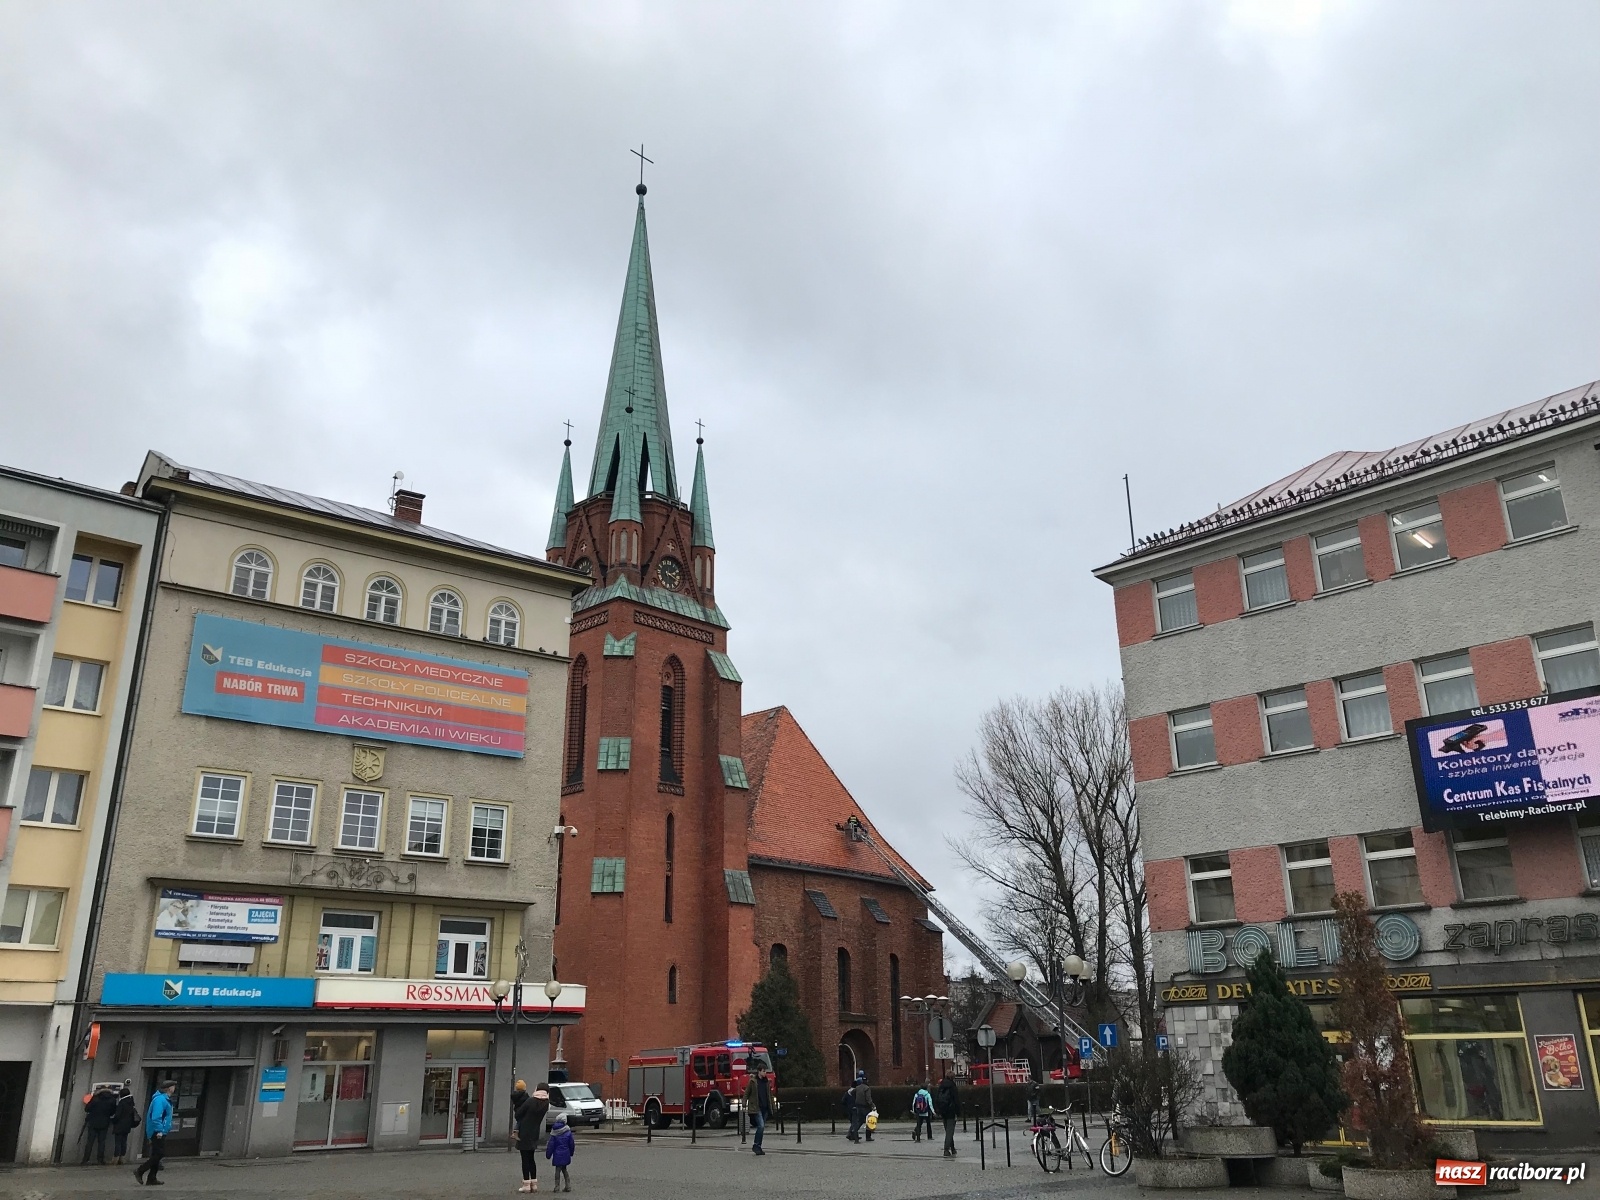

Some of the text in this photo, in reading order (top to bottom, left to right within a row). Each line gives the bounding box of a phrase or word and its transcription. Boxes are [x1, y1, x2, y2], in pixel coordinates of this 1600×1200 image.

[228, 655, 312, 677] TEB Edukacja
[345, 653, 504, 688] SZKOŁY MEDYCZNE
[222, 677, 299, 697] NABÓR TRWA
[342, 673, 511, 708] SZKOŁY POLICEALNE
[341, 693, 443, 716] TECHNIKUM
[1471, 696, 1549, 717] tel. 533 355 677
[338, 715, 501, 745] AKADEMIA III WIEKU
[1438, 741, 1578, 771] Kolektory danych
[1447, 751, 1585, 779] szybka inwentaryzacja
[1443, 774, 1592, 804] Centrum Kas Fiskalnych
[1478, 799, 1587, 822] Telebimy-Raciborz.pl
[187, 987, 262, 999] TEB Edukacja
[406, 984, 508, 1003] ROSSMAN
[1082, 1039, 1090, 1053] P
[1160, 1036, 1168, 1046] P
[1546, 1042, 1572, 1055] Bolko
